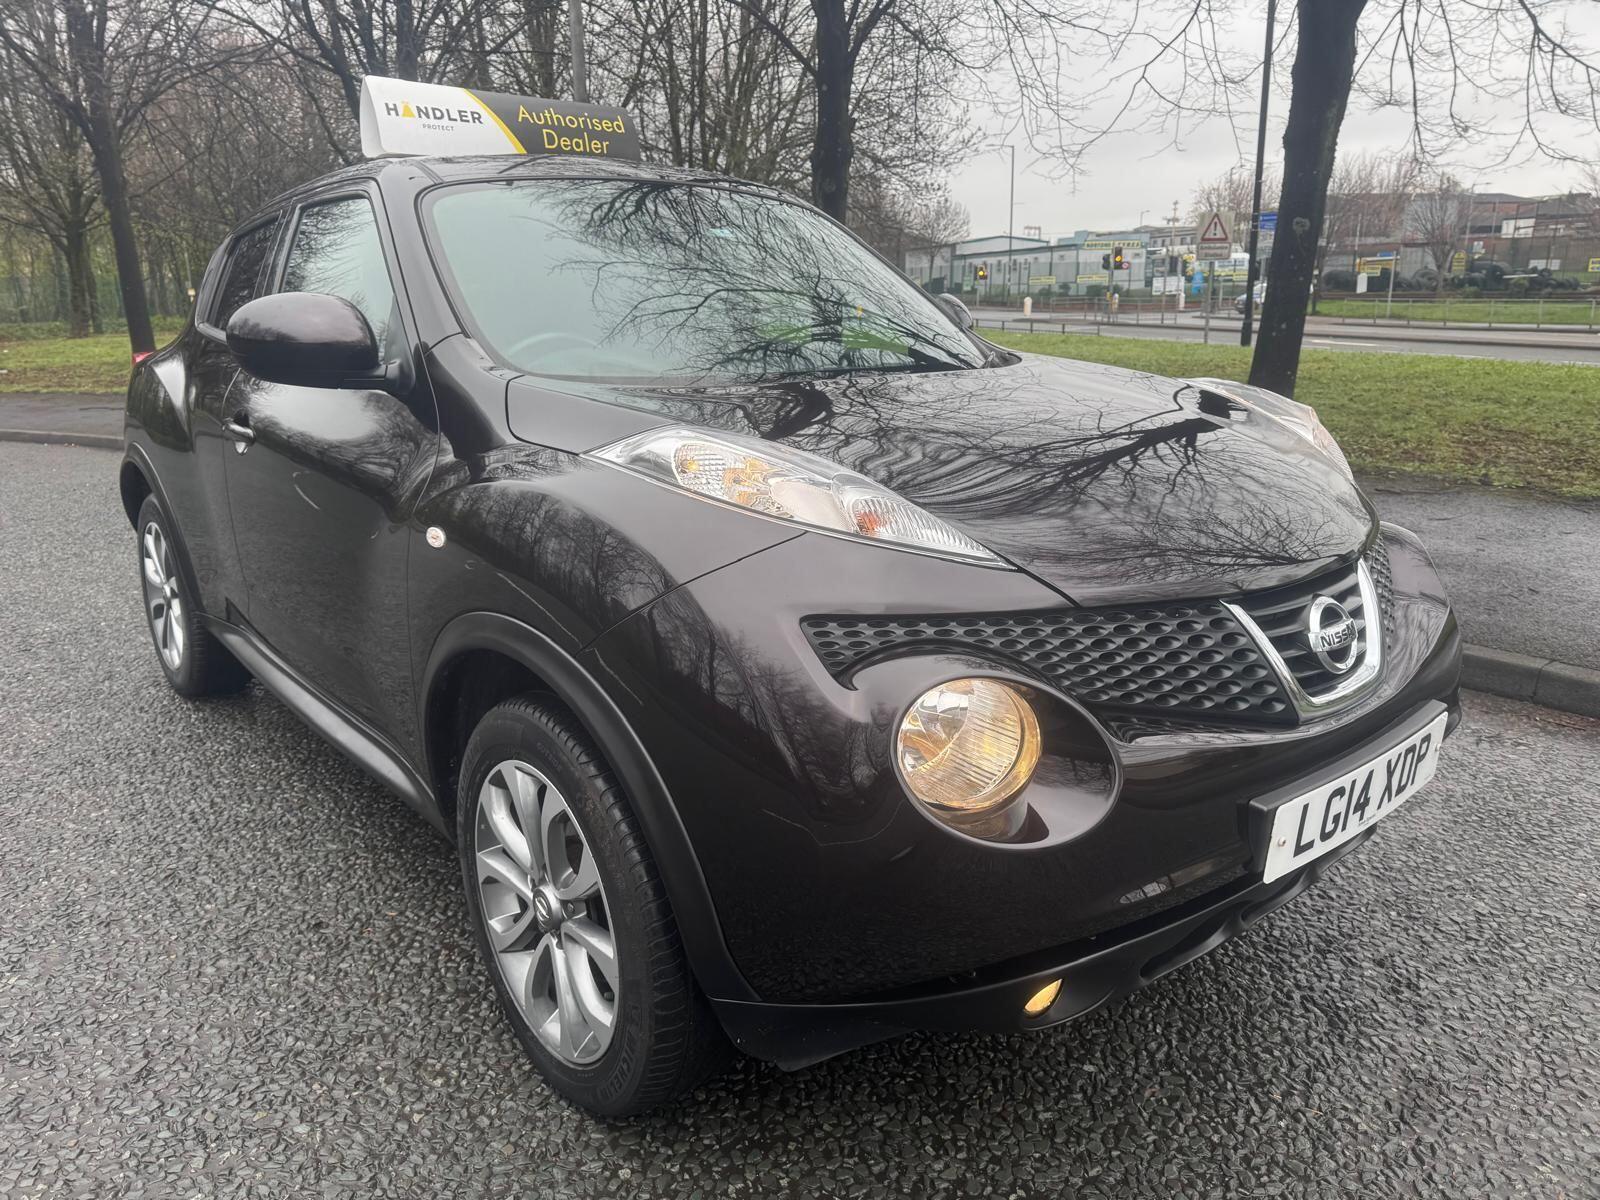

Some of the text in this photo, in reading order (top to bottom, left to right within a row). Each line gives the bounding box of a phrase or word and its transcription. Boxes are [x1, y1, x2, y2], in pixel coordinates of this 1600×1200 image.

[422, 123, 454, 132] PROTECT
[518, 104, 625, 133] Authorised
[542, 129, 609, 154] Dealer
[1293, 733, 1431, 858] LG14 XDP
